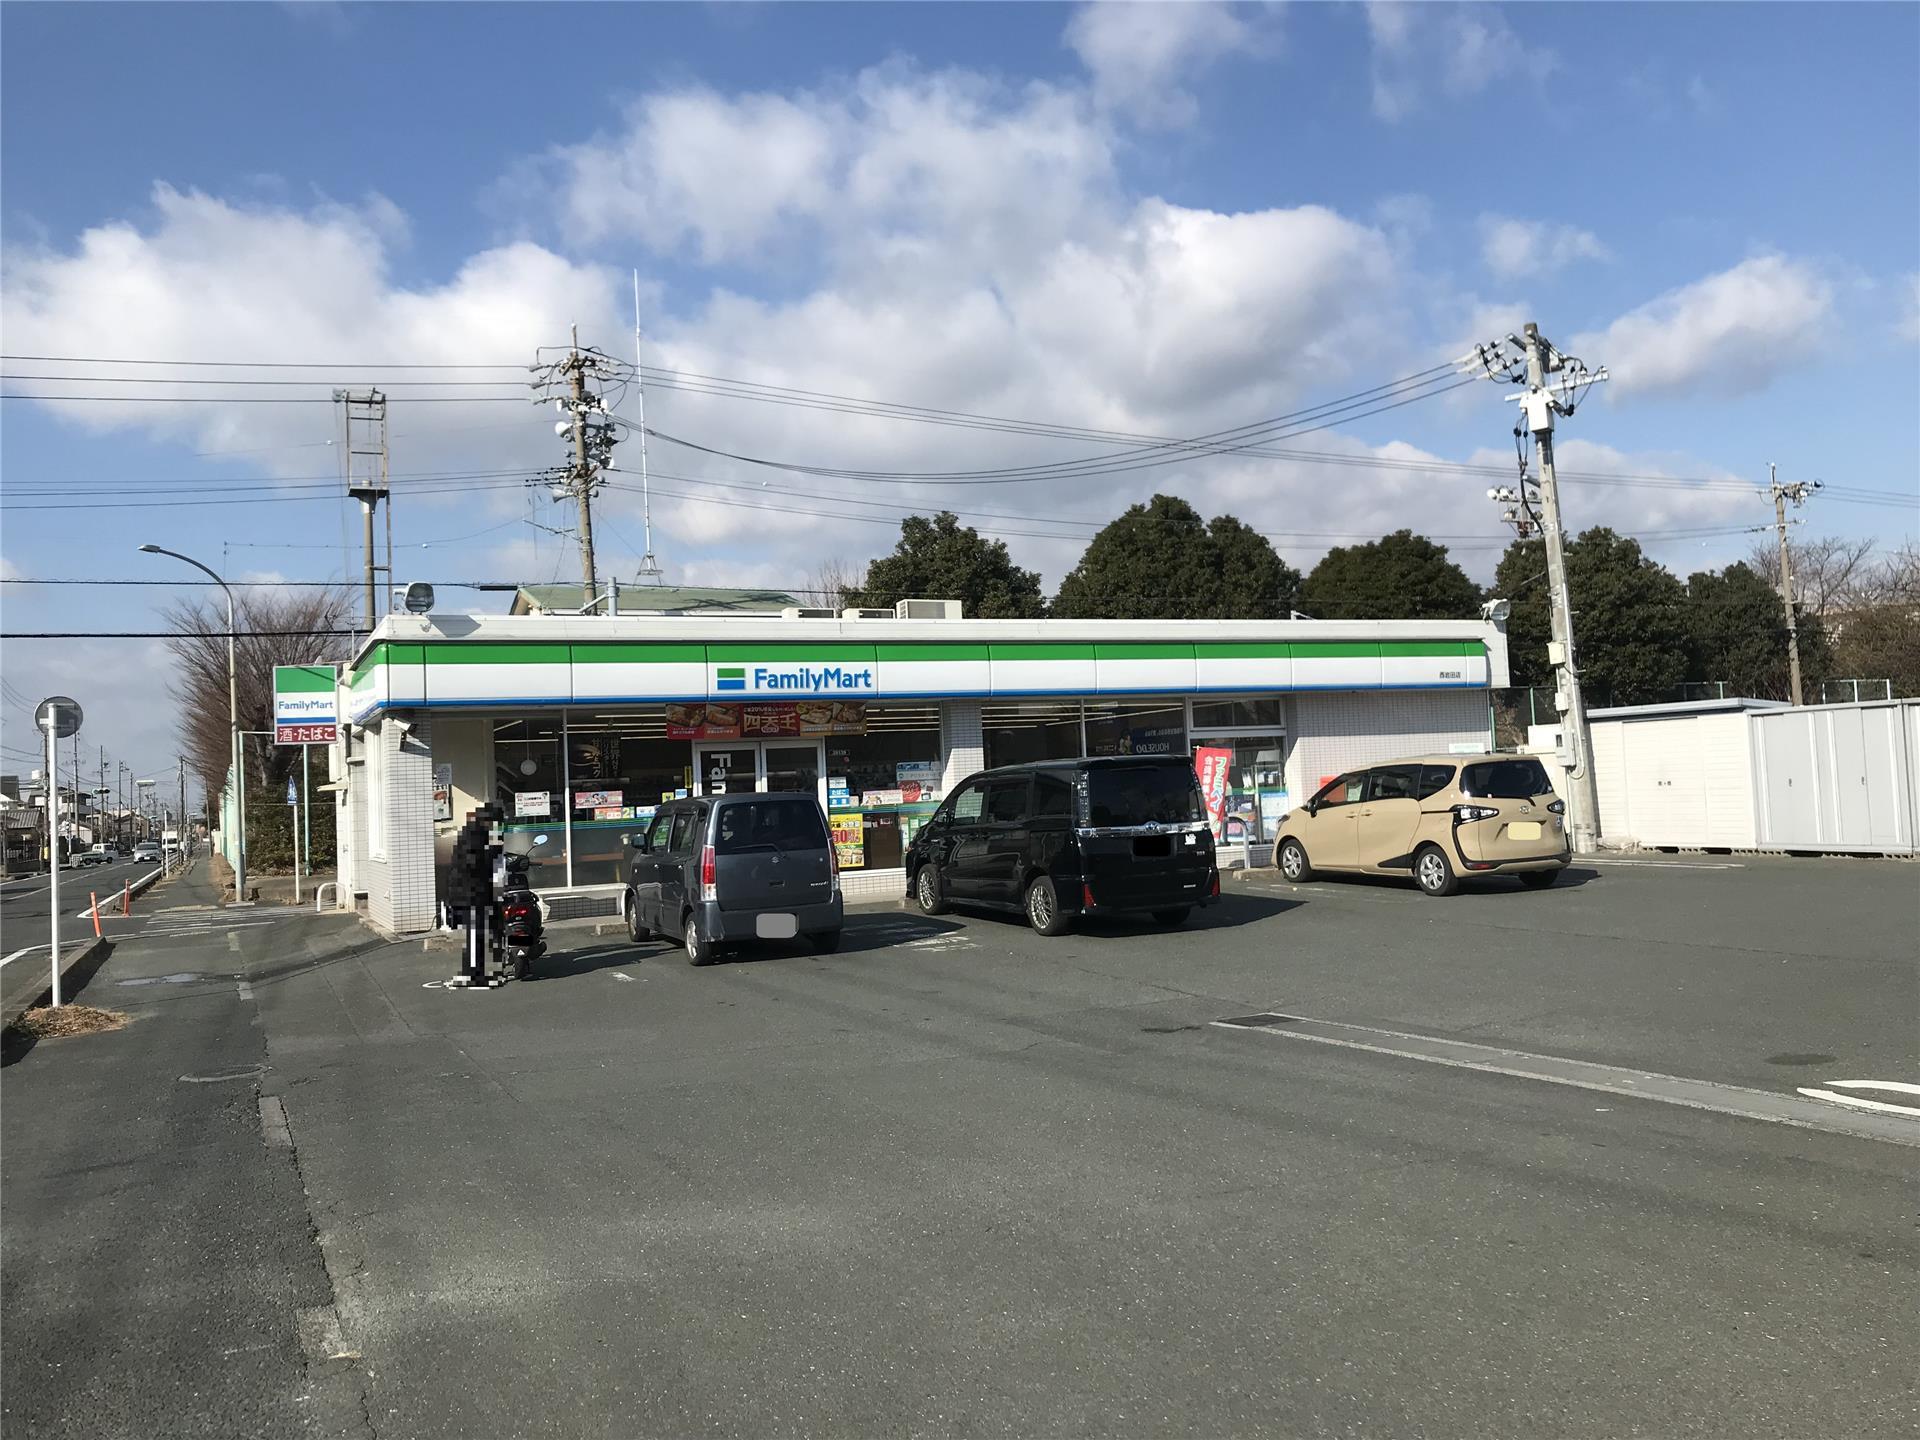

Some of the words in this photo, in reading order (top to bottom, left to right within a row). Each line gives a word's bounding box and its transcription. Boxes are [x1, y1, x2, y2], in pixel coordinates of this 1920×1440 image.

[754, 667, 872, 692] FamilyMart
[278, 700, 334, 711] FamilyMart
[279, 727, 336, 742] 酒・たばこ
